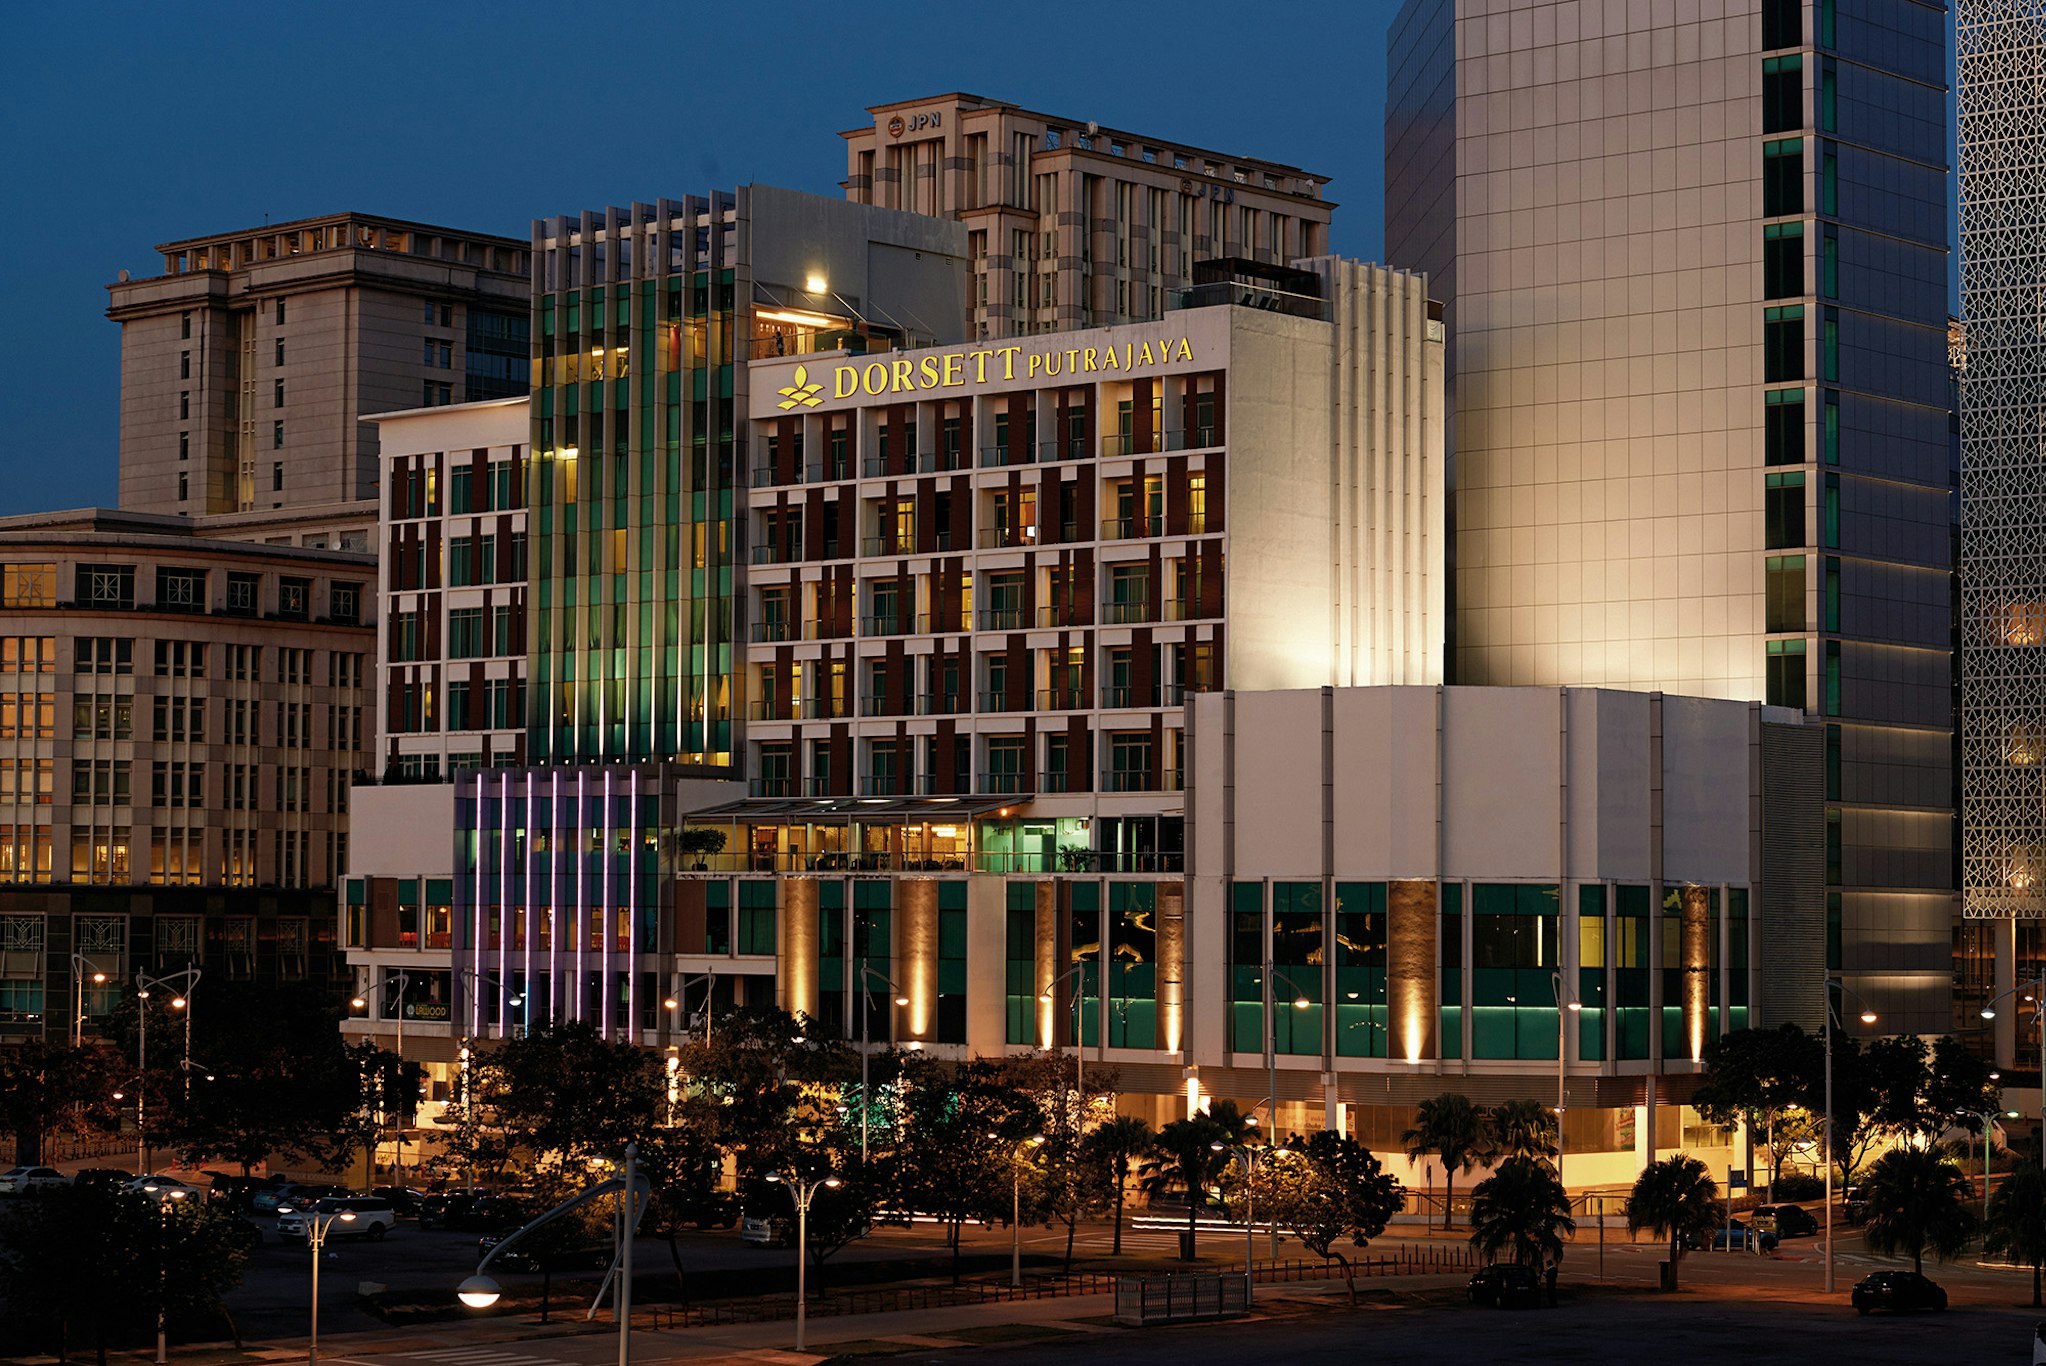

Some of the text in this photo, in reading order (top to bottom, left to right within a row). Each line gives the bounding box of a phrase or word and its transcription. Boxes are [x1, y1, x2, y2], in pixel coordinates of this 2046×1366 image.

[908, 111, 941, 131] JPN
[1199, 182, 1234, 203] JPN
[833, 337, 1194, 398] DORSETT PUTRAJAYA
